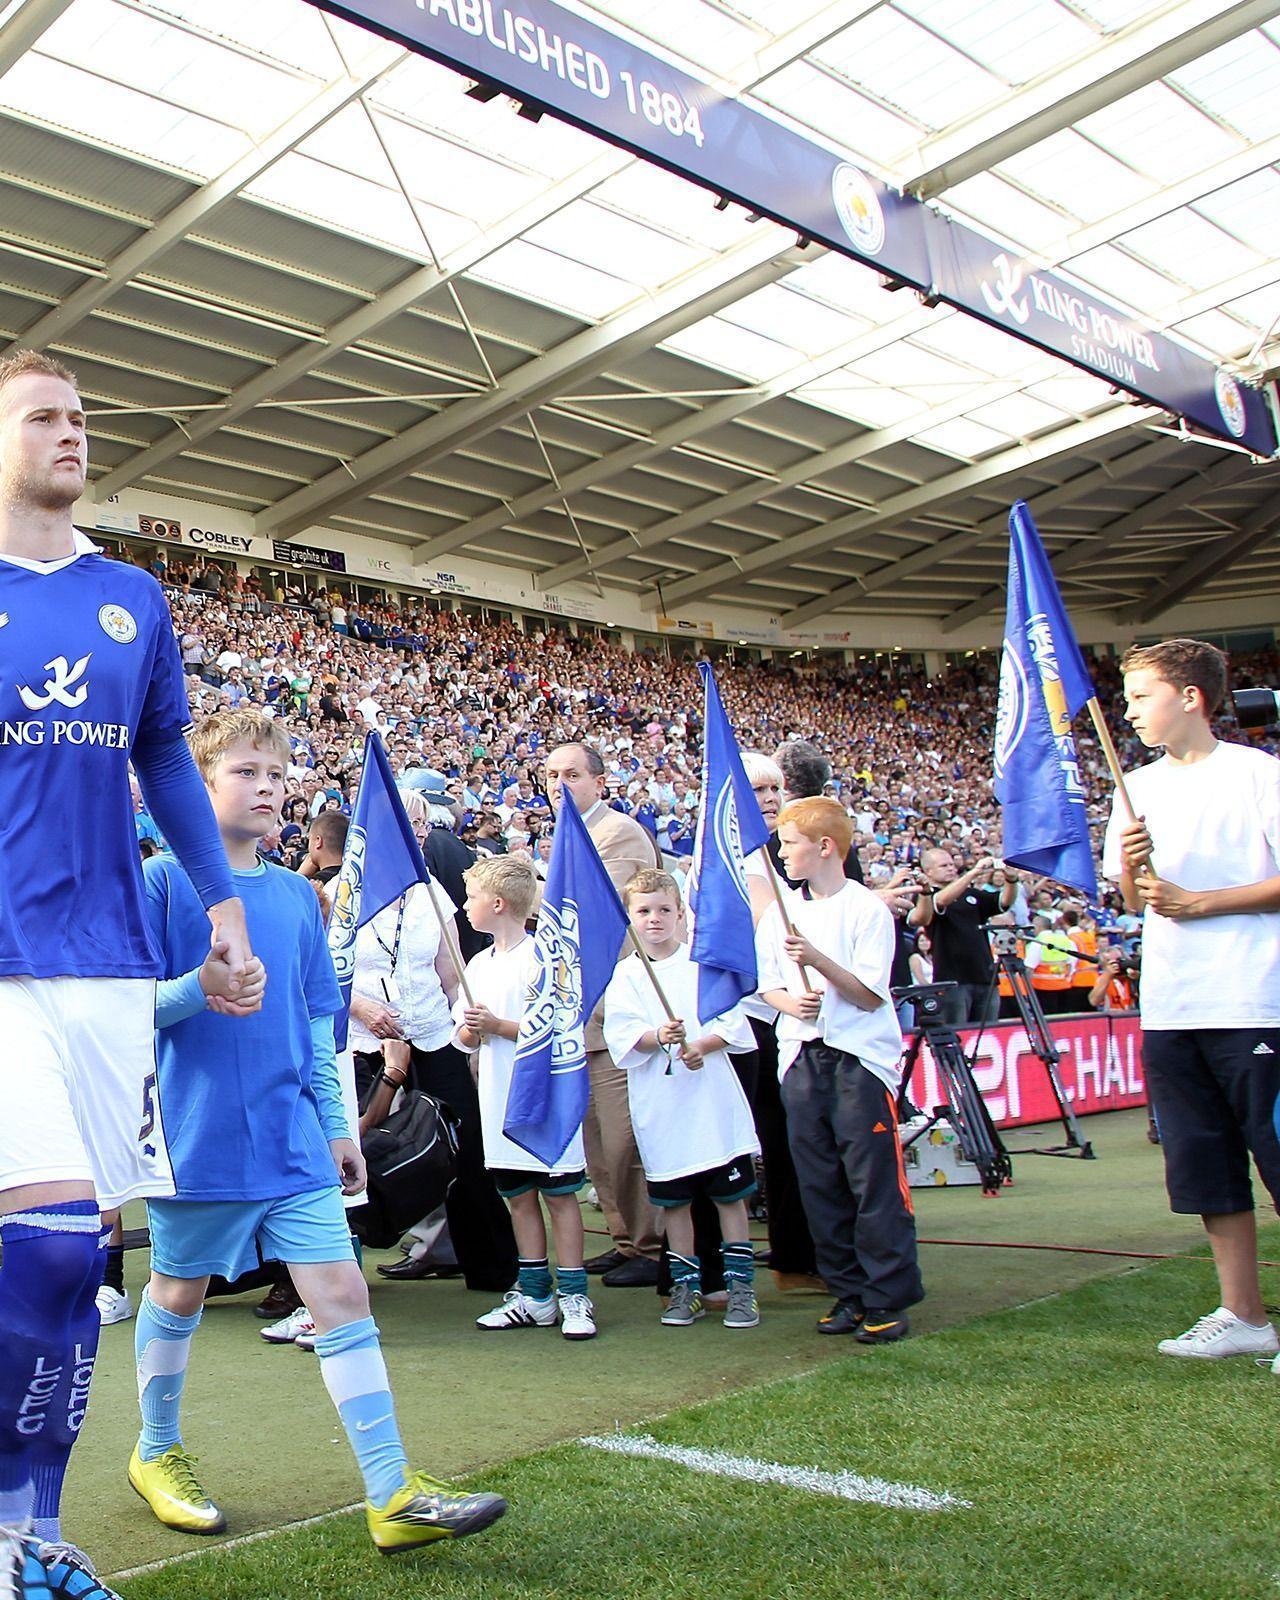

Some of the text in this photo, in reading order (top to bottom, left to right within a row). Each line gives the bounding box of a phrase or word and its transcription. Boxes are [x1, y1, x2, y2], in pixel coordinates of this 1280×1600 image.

[416, 0, 705, 148] ABLISHED 1884
[1028, 274, 1161, 373] KING POWER
[1070, 333, 1137, 385] STADIUM
[189, 528, 253, 552] COBLEY
[291, 548, 320, 563] graphite
[320, 552, 330, 565] uk
[51, 720, 129, 749] POWER
[15, 1356, 63, 1435] LCFC
